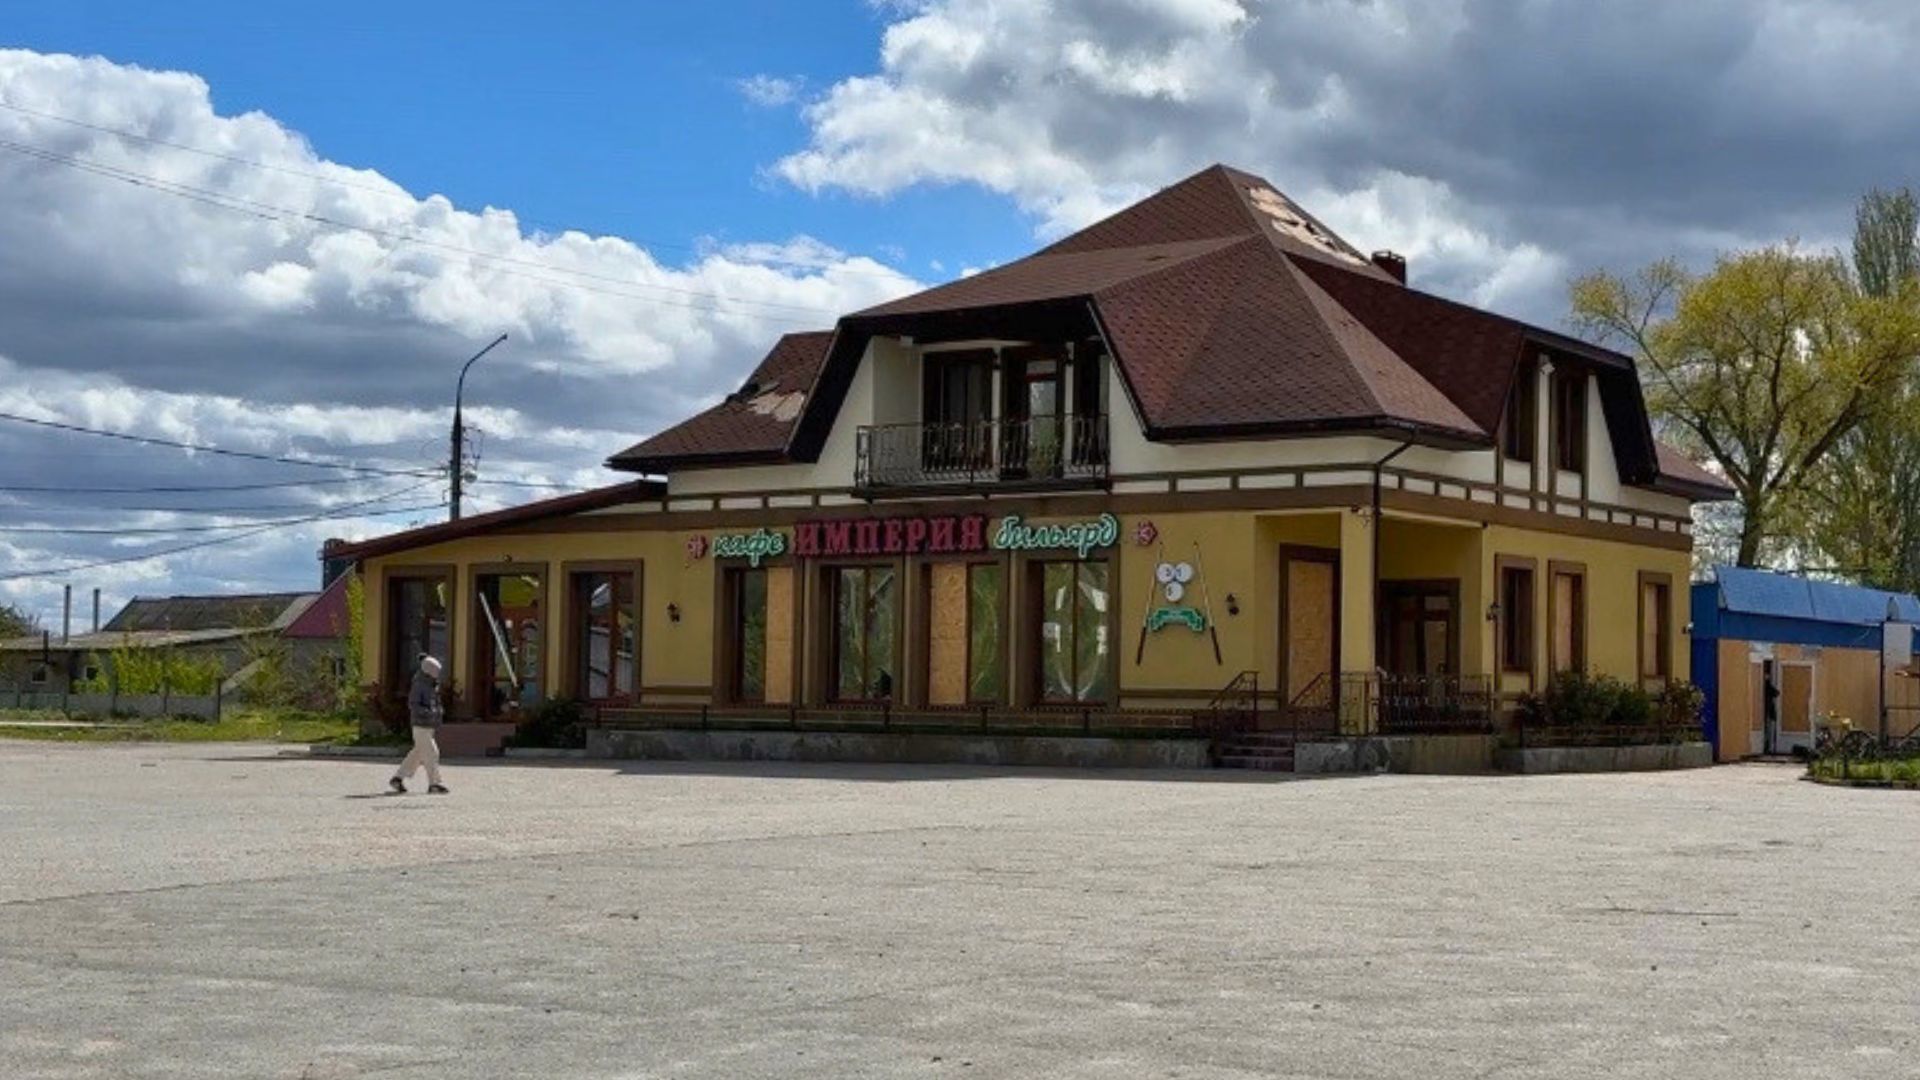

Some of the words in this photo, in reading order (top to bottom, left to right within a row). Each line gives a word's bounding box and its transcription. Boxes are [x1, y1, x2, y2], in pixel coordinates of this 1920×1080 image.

[712, 528, 785, 568] кафе
[797, 516, 983, 555] ИМПЕРИЯ
[994, 513, 1117, 558] бильярд
